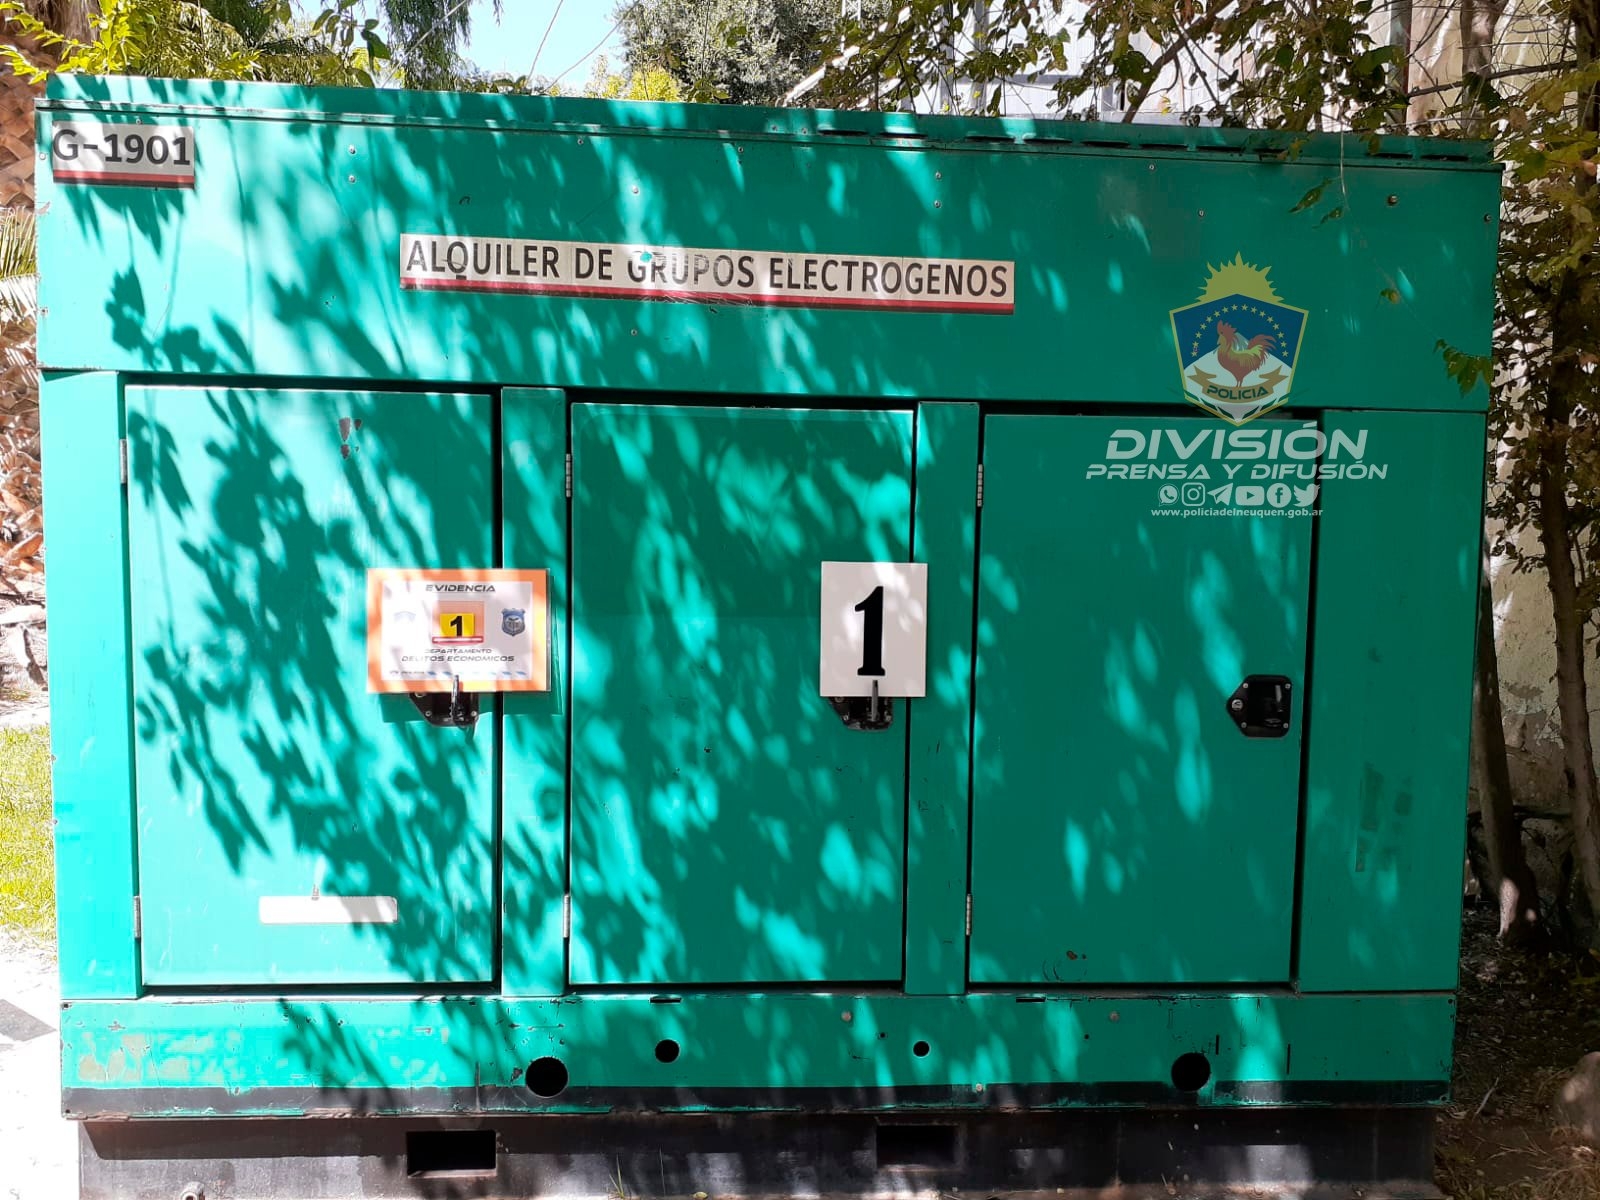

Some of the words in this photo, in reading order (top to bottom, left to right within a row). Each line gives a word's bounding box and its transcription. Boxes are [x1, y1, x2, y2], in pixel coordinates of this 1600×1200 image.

[53, 128, 191, 165] G-1901
[405, 240, 561, 280] ALQUILER
[574, 247, 613, 281] DE
[627, 250, 755, 288] GRUPOS
[769, 256, 1008, 297] ELECTROGENOS
[425, 584, 496, 592] EVIDENCIA
[450, 615, 463, 637] 1
[854, 585, 886, 677] 1
